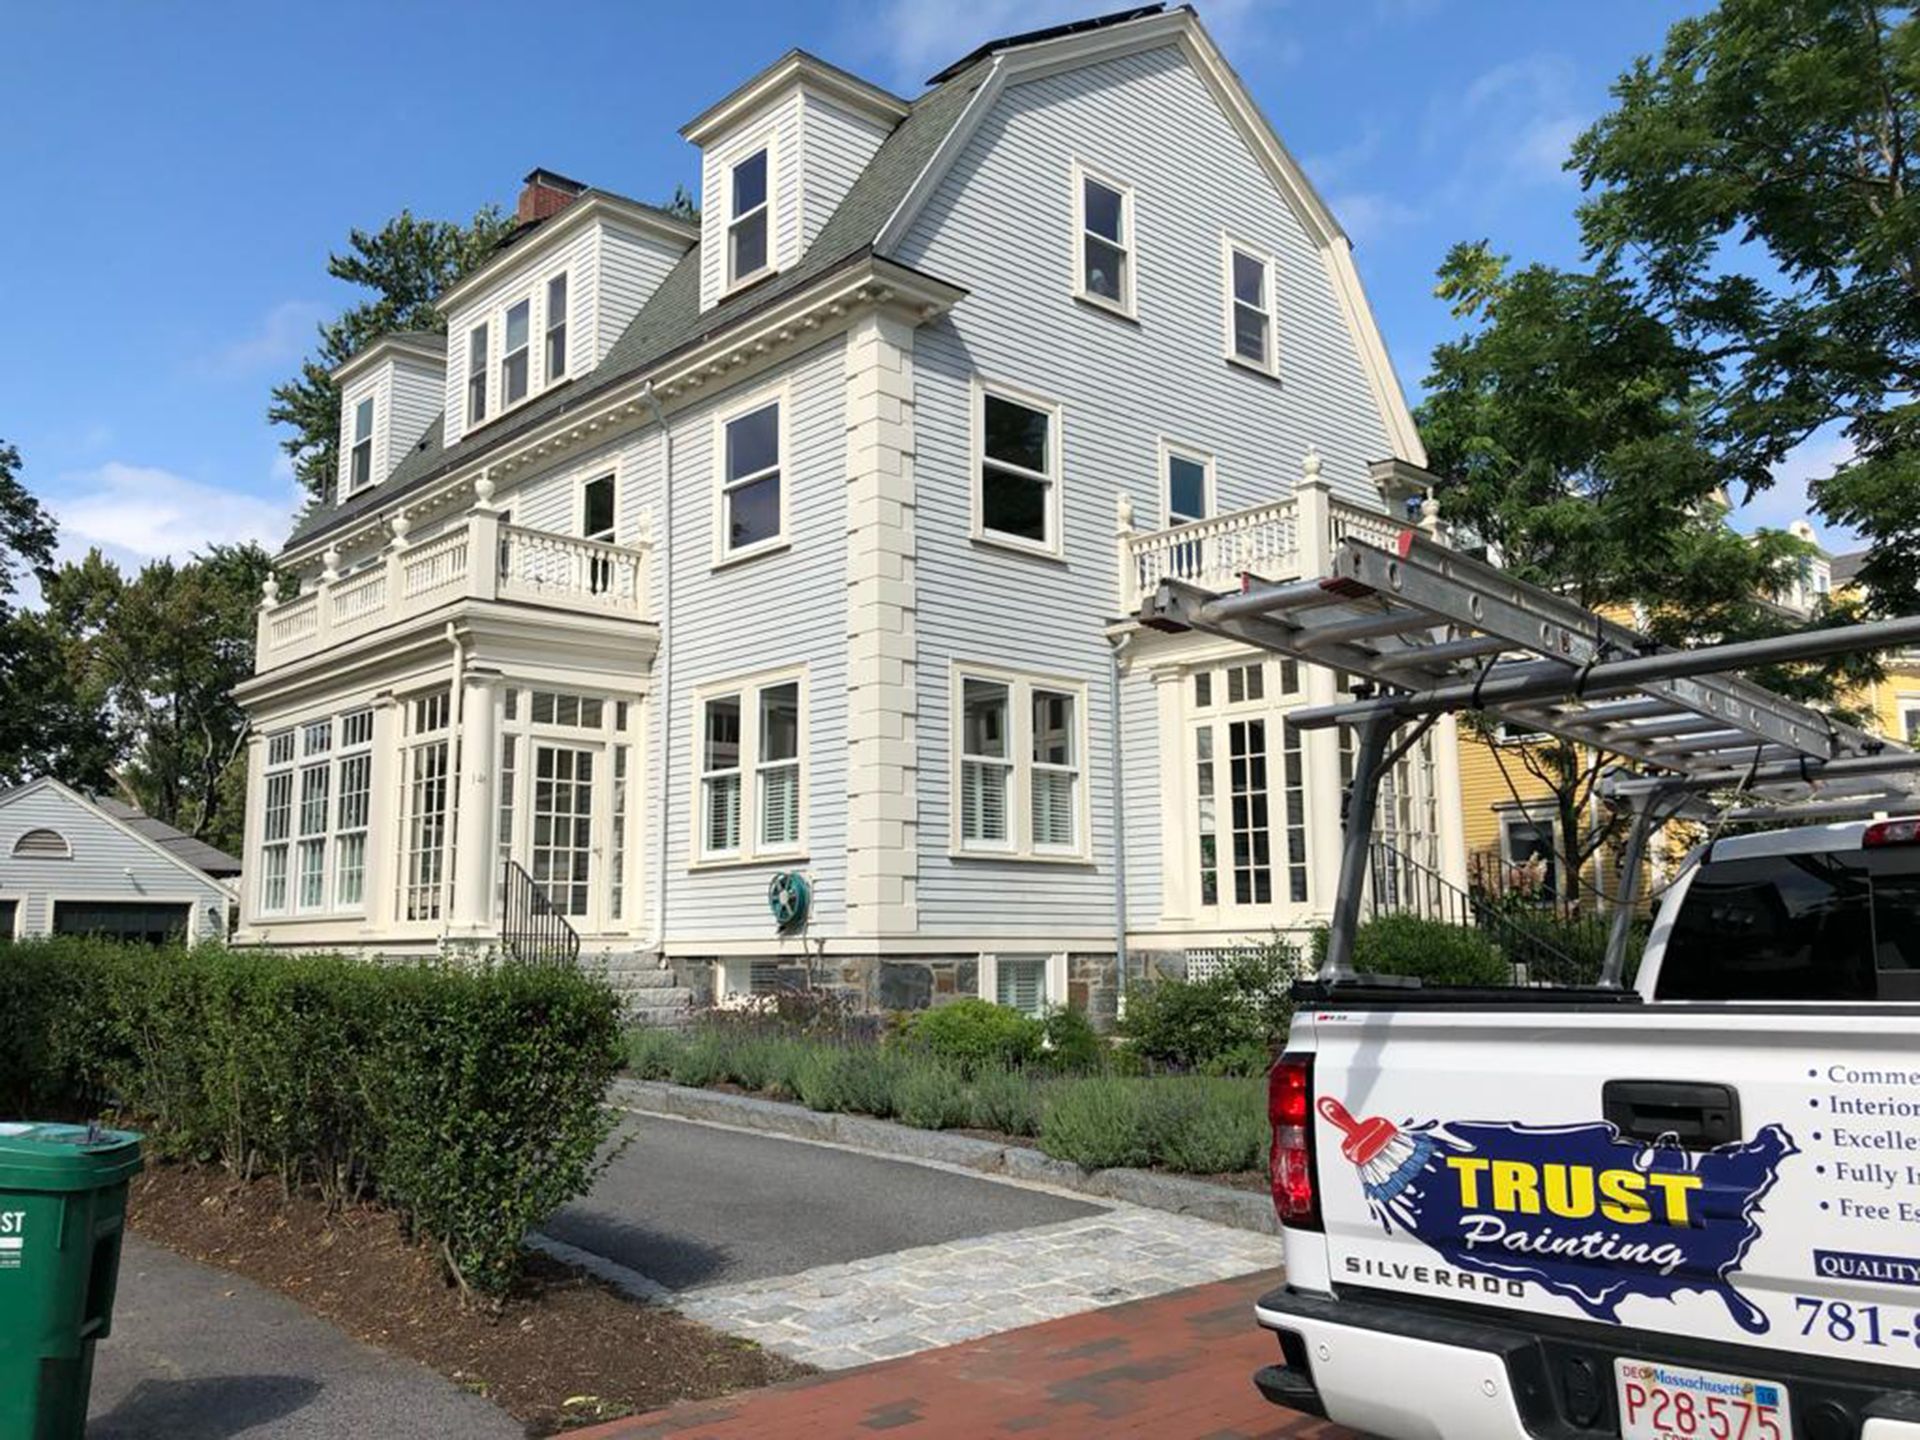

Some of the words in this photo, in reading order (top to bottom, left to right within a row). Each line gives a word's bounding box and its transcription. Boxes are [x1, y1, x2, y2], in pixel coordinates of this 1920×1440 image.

[1827, 1065, 1920, 1086] Comme
[1835, 1161, 1898, 1190] Fully
[1905, 1166, 1920, 1185] I
[1446, 1156, 1703, 1228] TRUST
[1838, 1198, 1890, 1220] Free
[1459, 1214, 1688, 1276] Painting
[1345, 1256, 1525, 1298] SILVERADO
[1820, 1256, 1920, 1281] QUALITY
[1795, 1296, 1920, 1349] 781-
[1652, 1368, 1745, 1396] Massachusett
